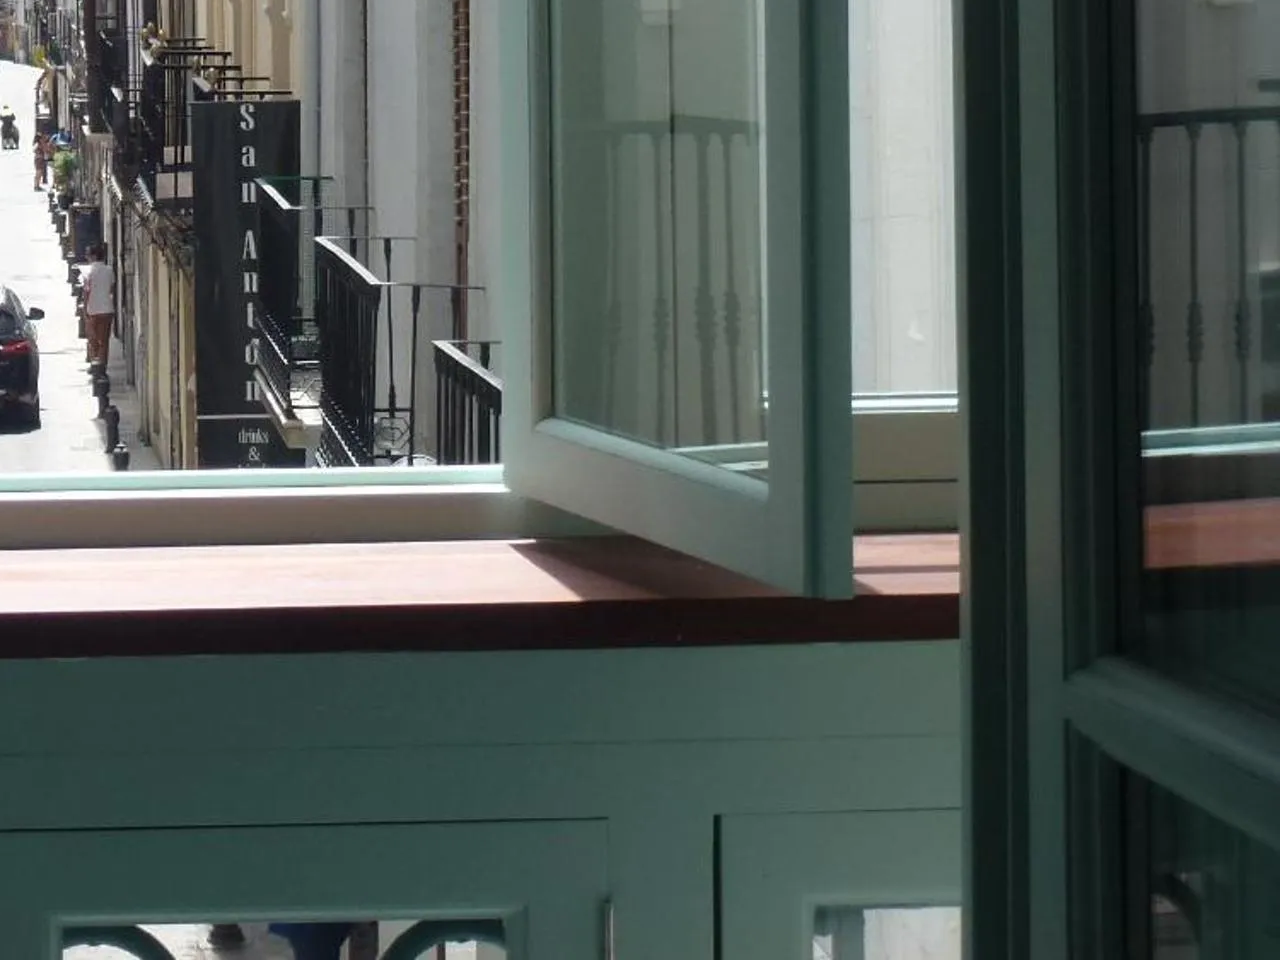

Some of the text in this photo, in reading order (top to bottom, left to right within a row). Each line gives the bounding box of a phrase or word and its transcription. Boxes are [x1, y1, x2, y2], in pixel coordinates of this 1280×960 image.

[240, 103, 257, 203] San
[238, 427, 269, 444] drinks
[248, 446, 261, 461] &
